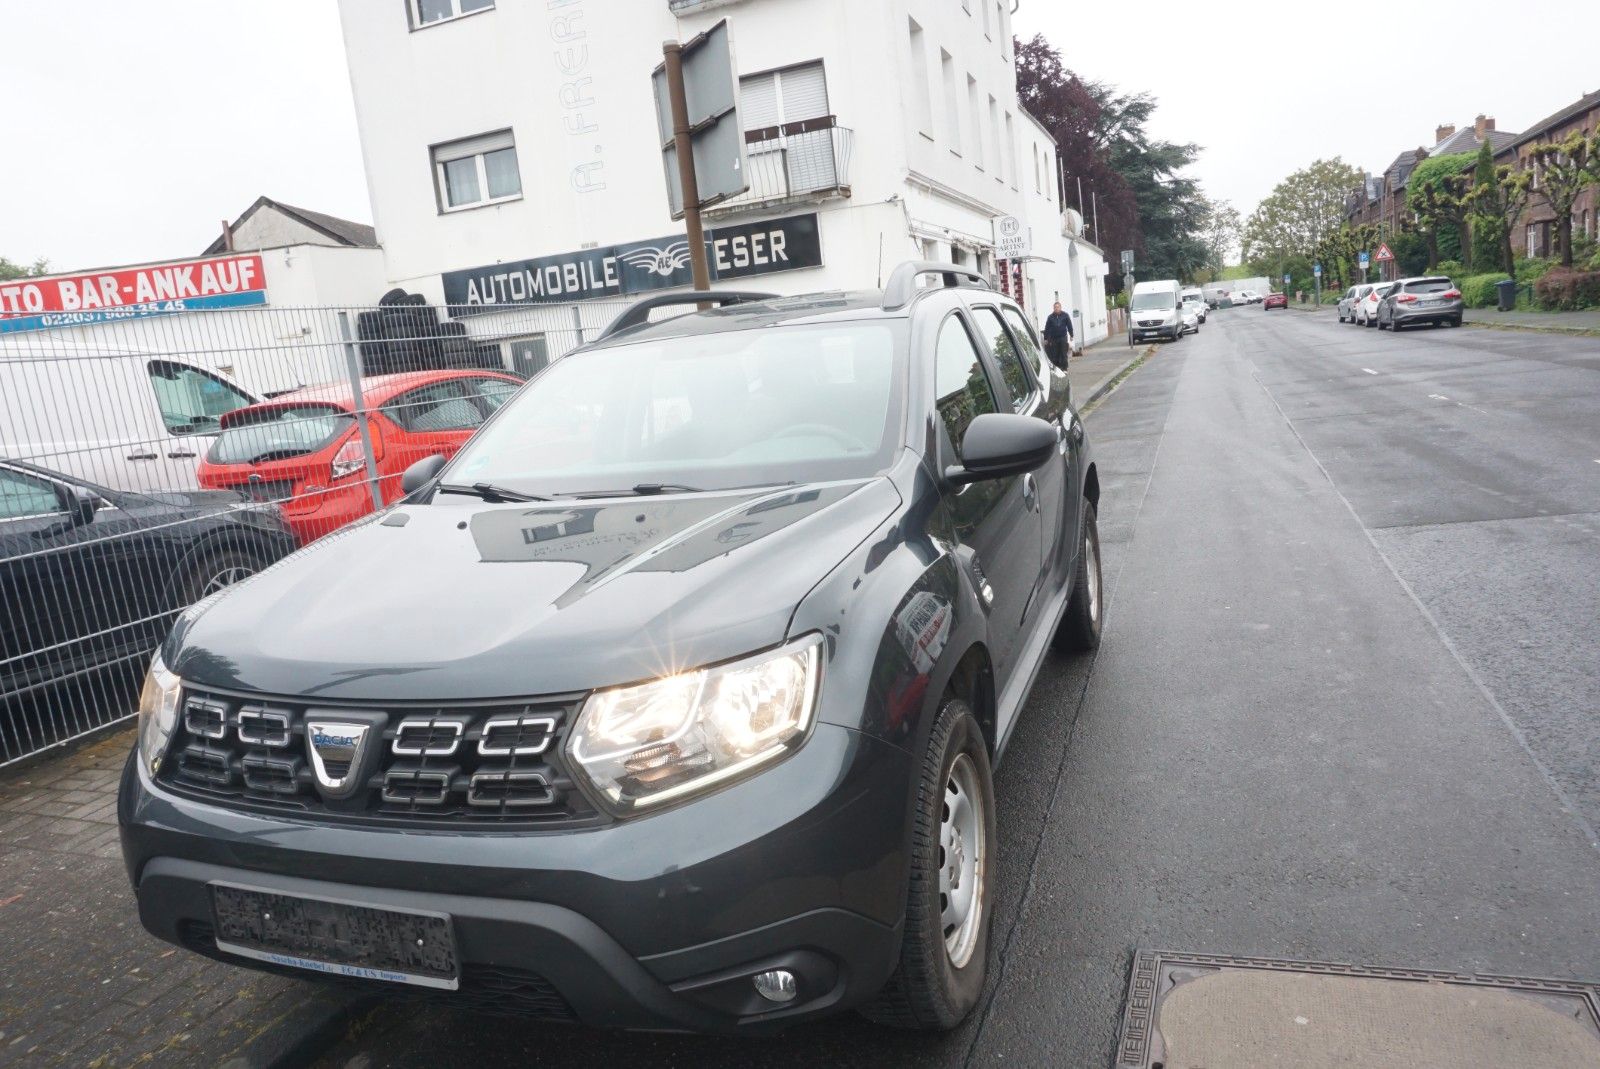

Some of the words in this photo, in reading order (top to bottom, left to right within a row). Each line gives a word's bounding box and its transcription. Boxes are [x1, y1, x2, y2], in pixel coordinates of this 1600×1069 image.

[999, 242, 1025, 251] ARTIST
[1002, 236, 1022, 244] HAIR
[467, 256, 619, 306] AUTOMOBILE
[713, 229, 789, 271] ESER
[0, 284, 44, 318] TO
[58, 259, 255, 311] BAR-ANKAUF
[164, 299, 186, 312] 45
[314, 734, 353, 747] DACIA
